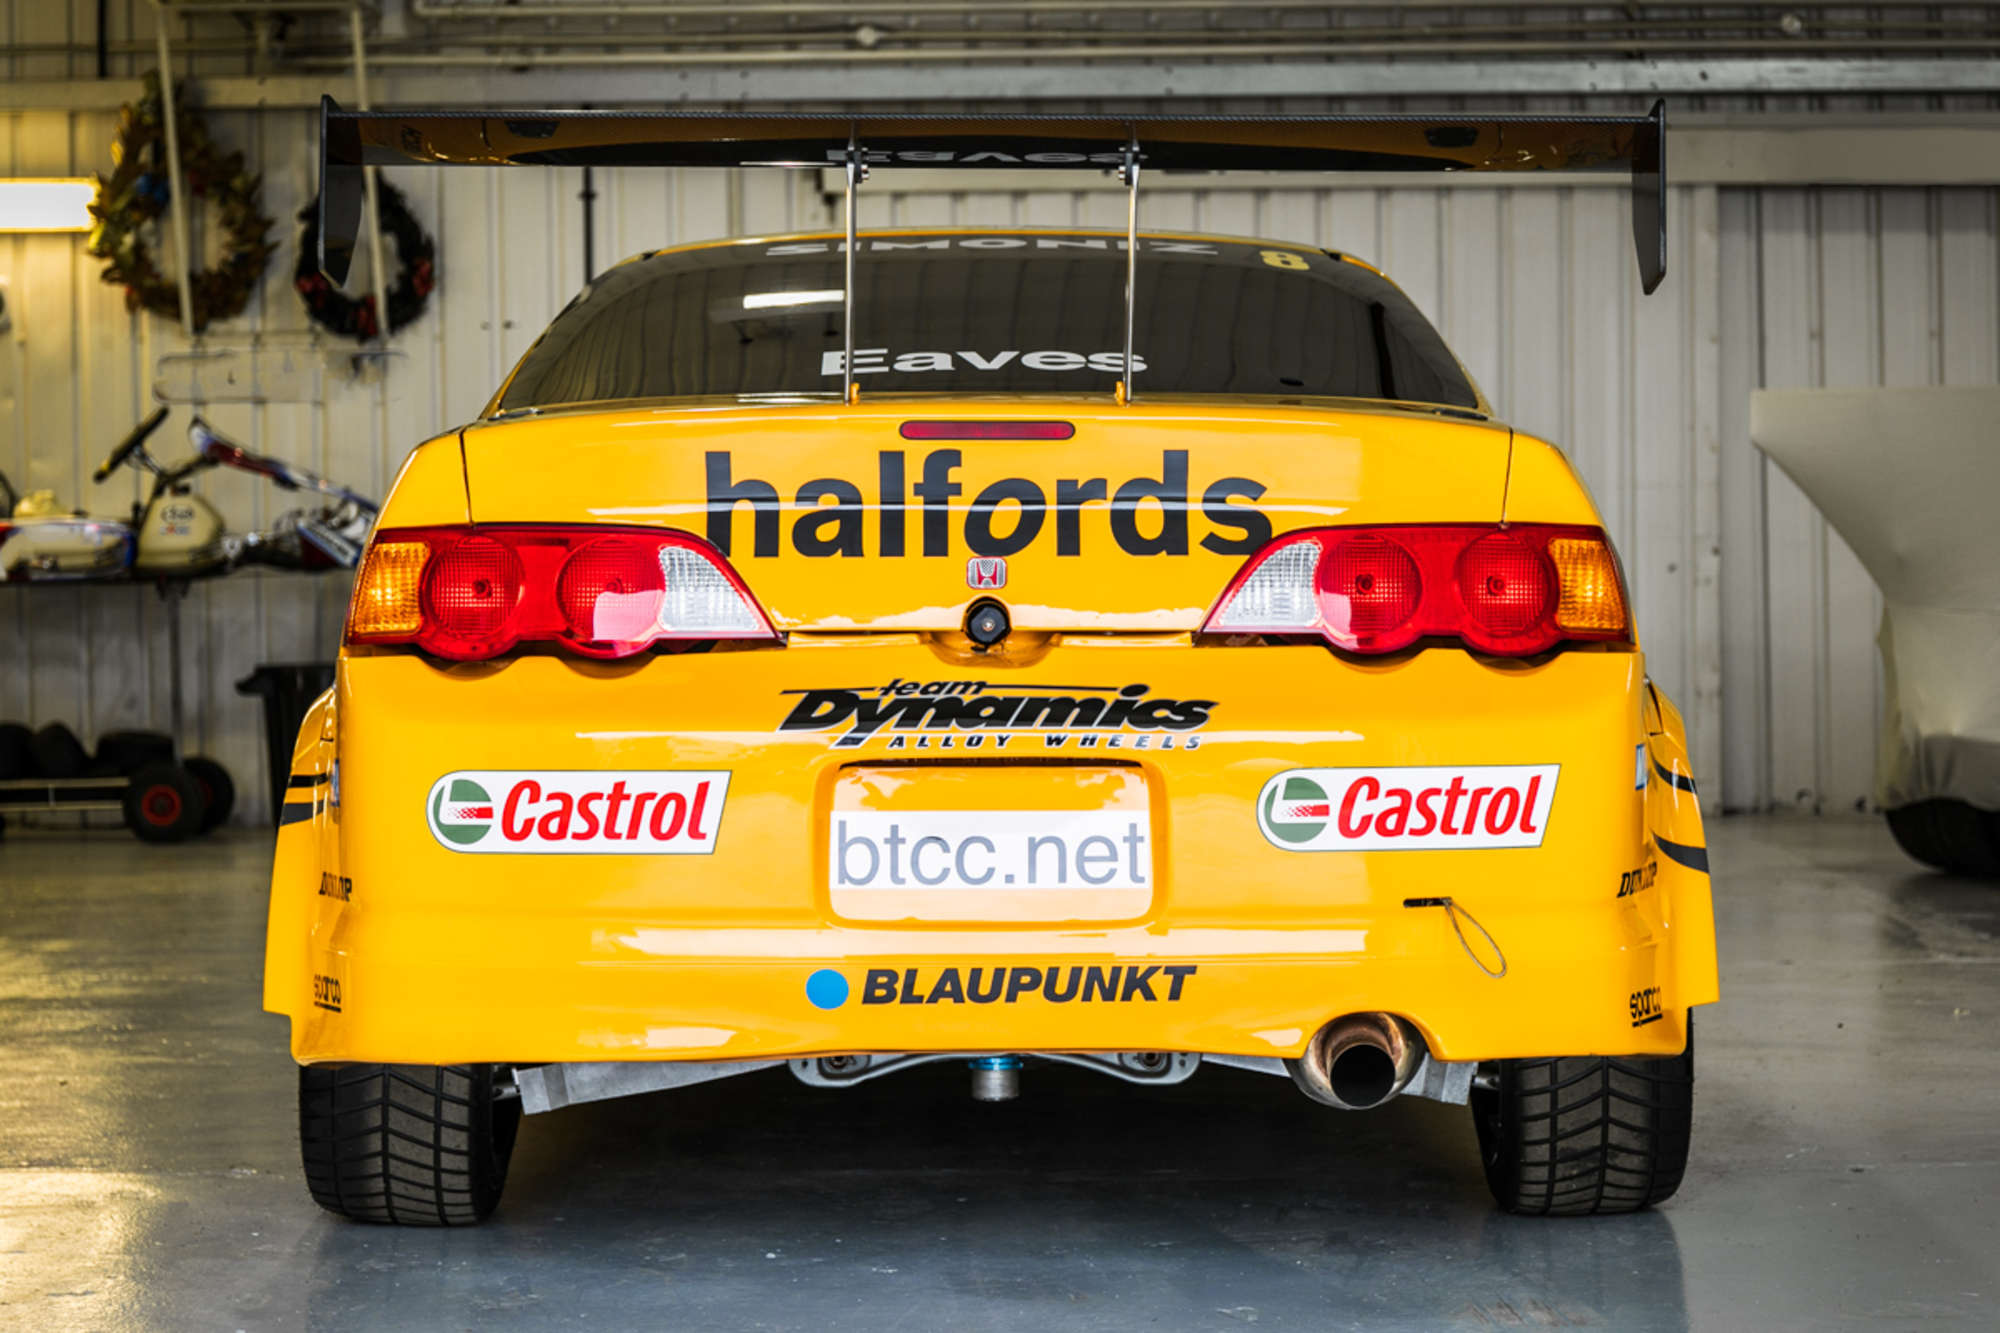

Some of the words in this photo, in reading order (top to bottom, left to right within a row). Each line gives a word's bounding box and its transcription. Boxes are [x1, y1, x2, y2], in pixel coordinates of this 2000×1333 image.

[766, 238, 1218, 257] SIMONIZ
[1259, 250, 1311, 271] 8
[821, 349, 1148, 376] Eaves
[705, 449, 1272, 558] halfords
[878, 678, 988, 697] team
[777, 684, 1220, 750] Dynamics
[888, 735, 1011, 748] ALLOY
[1045, 734, 1200, 749] WHEELS
[502, 779, 710, 841] Castrol
[1338, 774, 1541, 839] Castrol
[836, 820, 1146, 886] btcc.net
[862, 965, 1197, 1005] BLAUPUNKT
